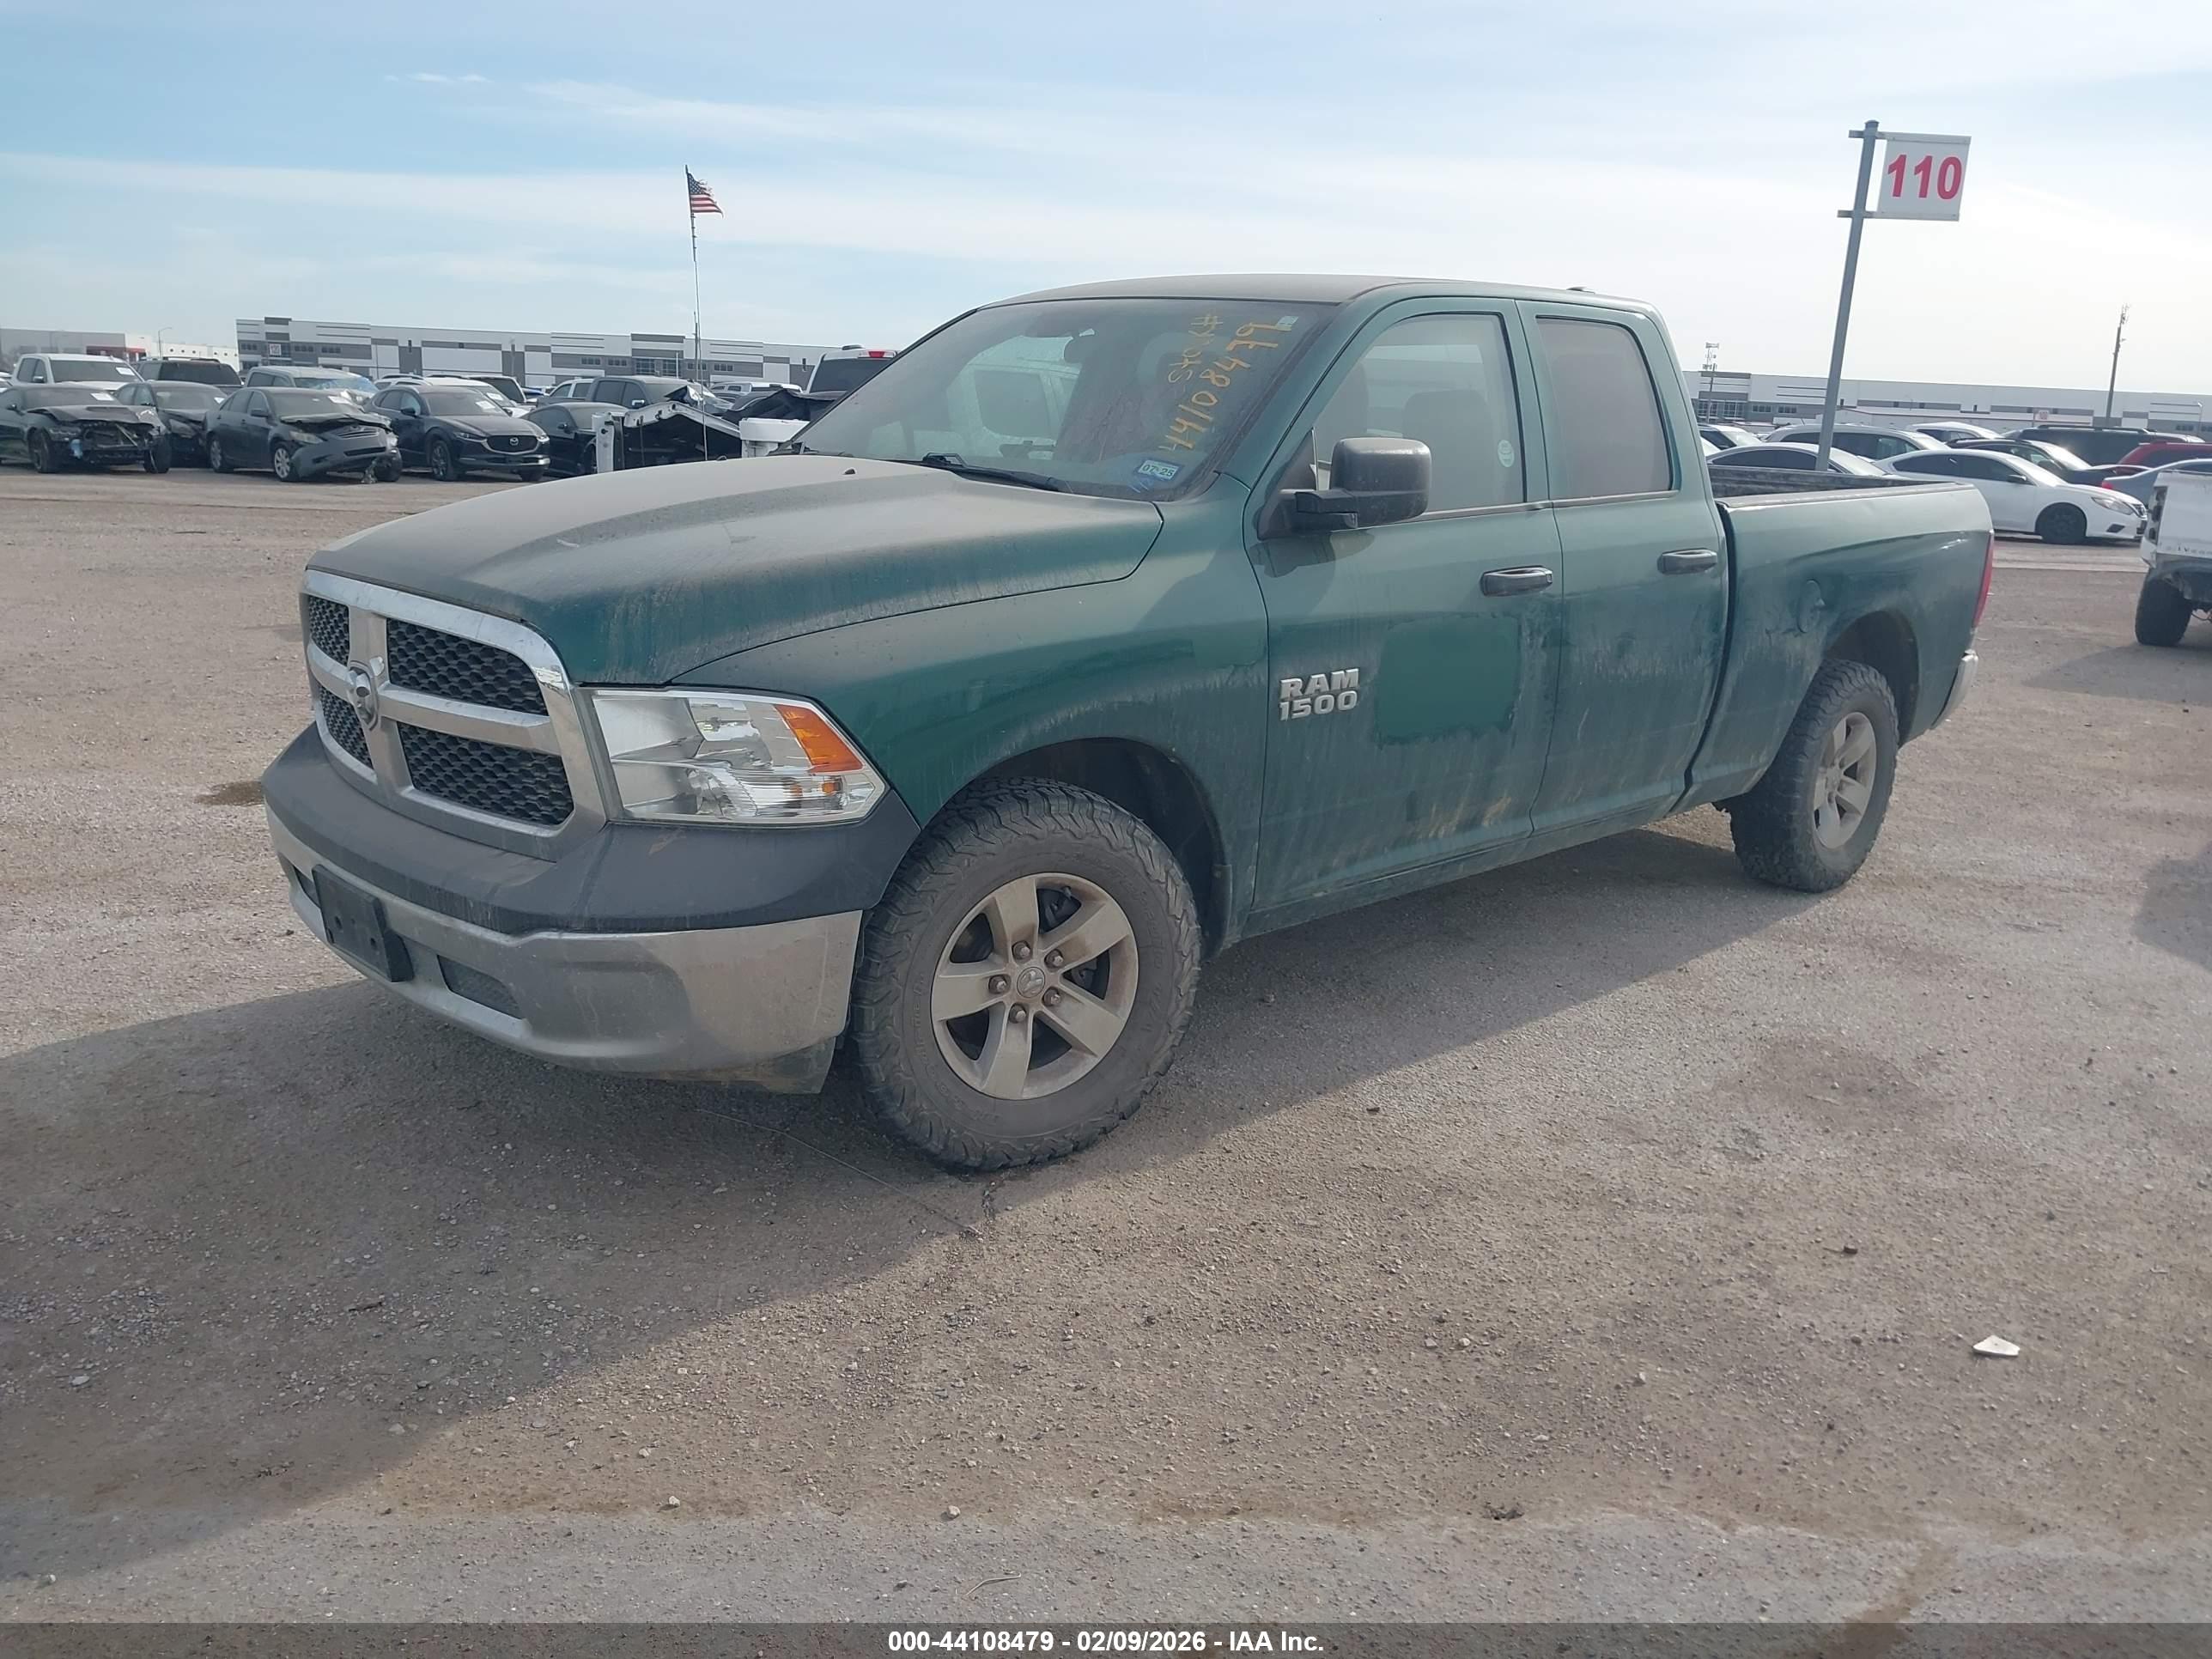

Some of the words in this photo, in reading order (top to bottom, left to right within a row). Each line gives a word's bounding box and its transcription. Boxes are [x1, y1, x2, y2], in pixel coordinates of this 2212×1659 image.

[1887, 154, 1962, 200] 110
[1158, 322, 1291, 450] 44108479
[1279, 667, 1359, 699] RAM
[1279, 690, 1358, 721] 1500
